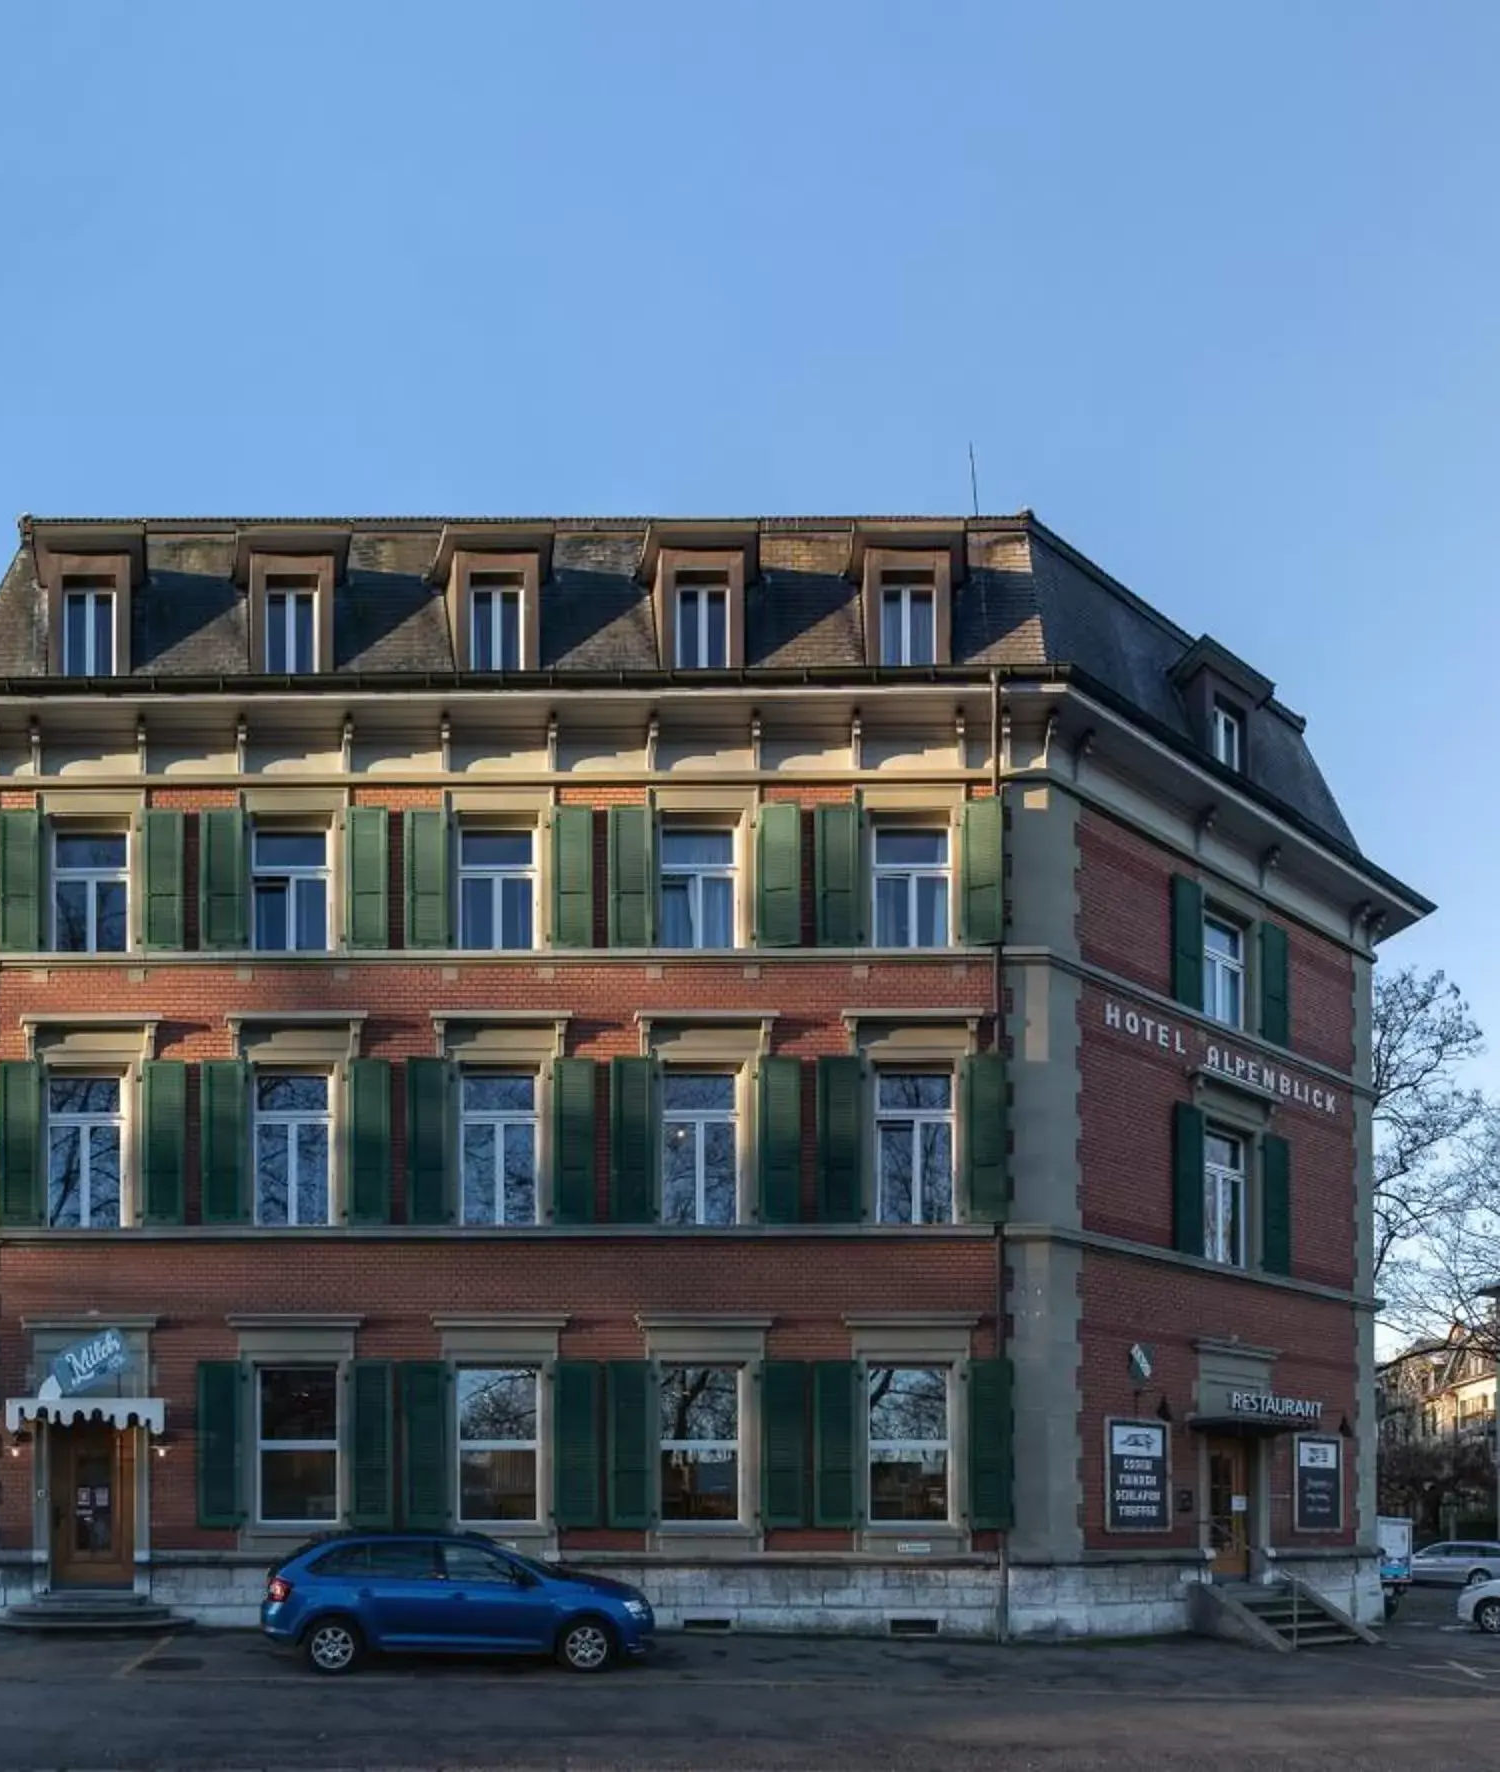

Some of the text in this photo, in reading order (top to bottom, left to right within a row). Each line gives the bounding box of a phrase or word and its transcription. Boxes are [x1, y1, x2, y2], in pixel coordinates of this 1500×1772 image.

[1105, 1003, 1336, 1114] HOTEL ALPENBLICK
[1232, 1391, 1323, 1419] RESTAURANT
